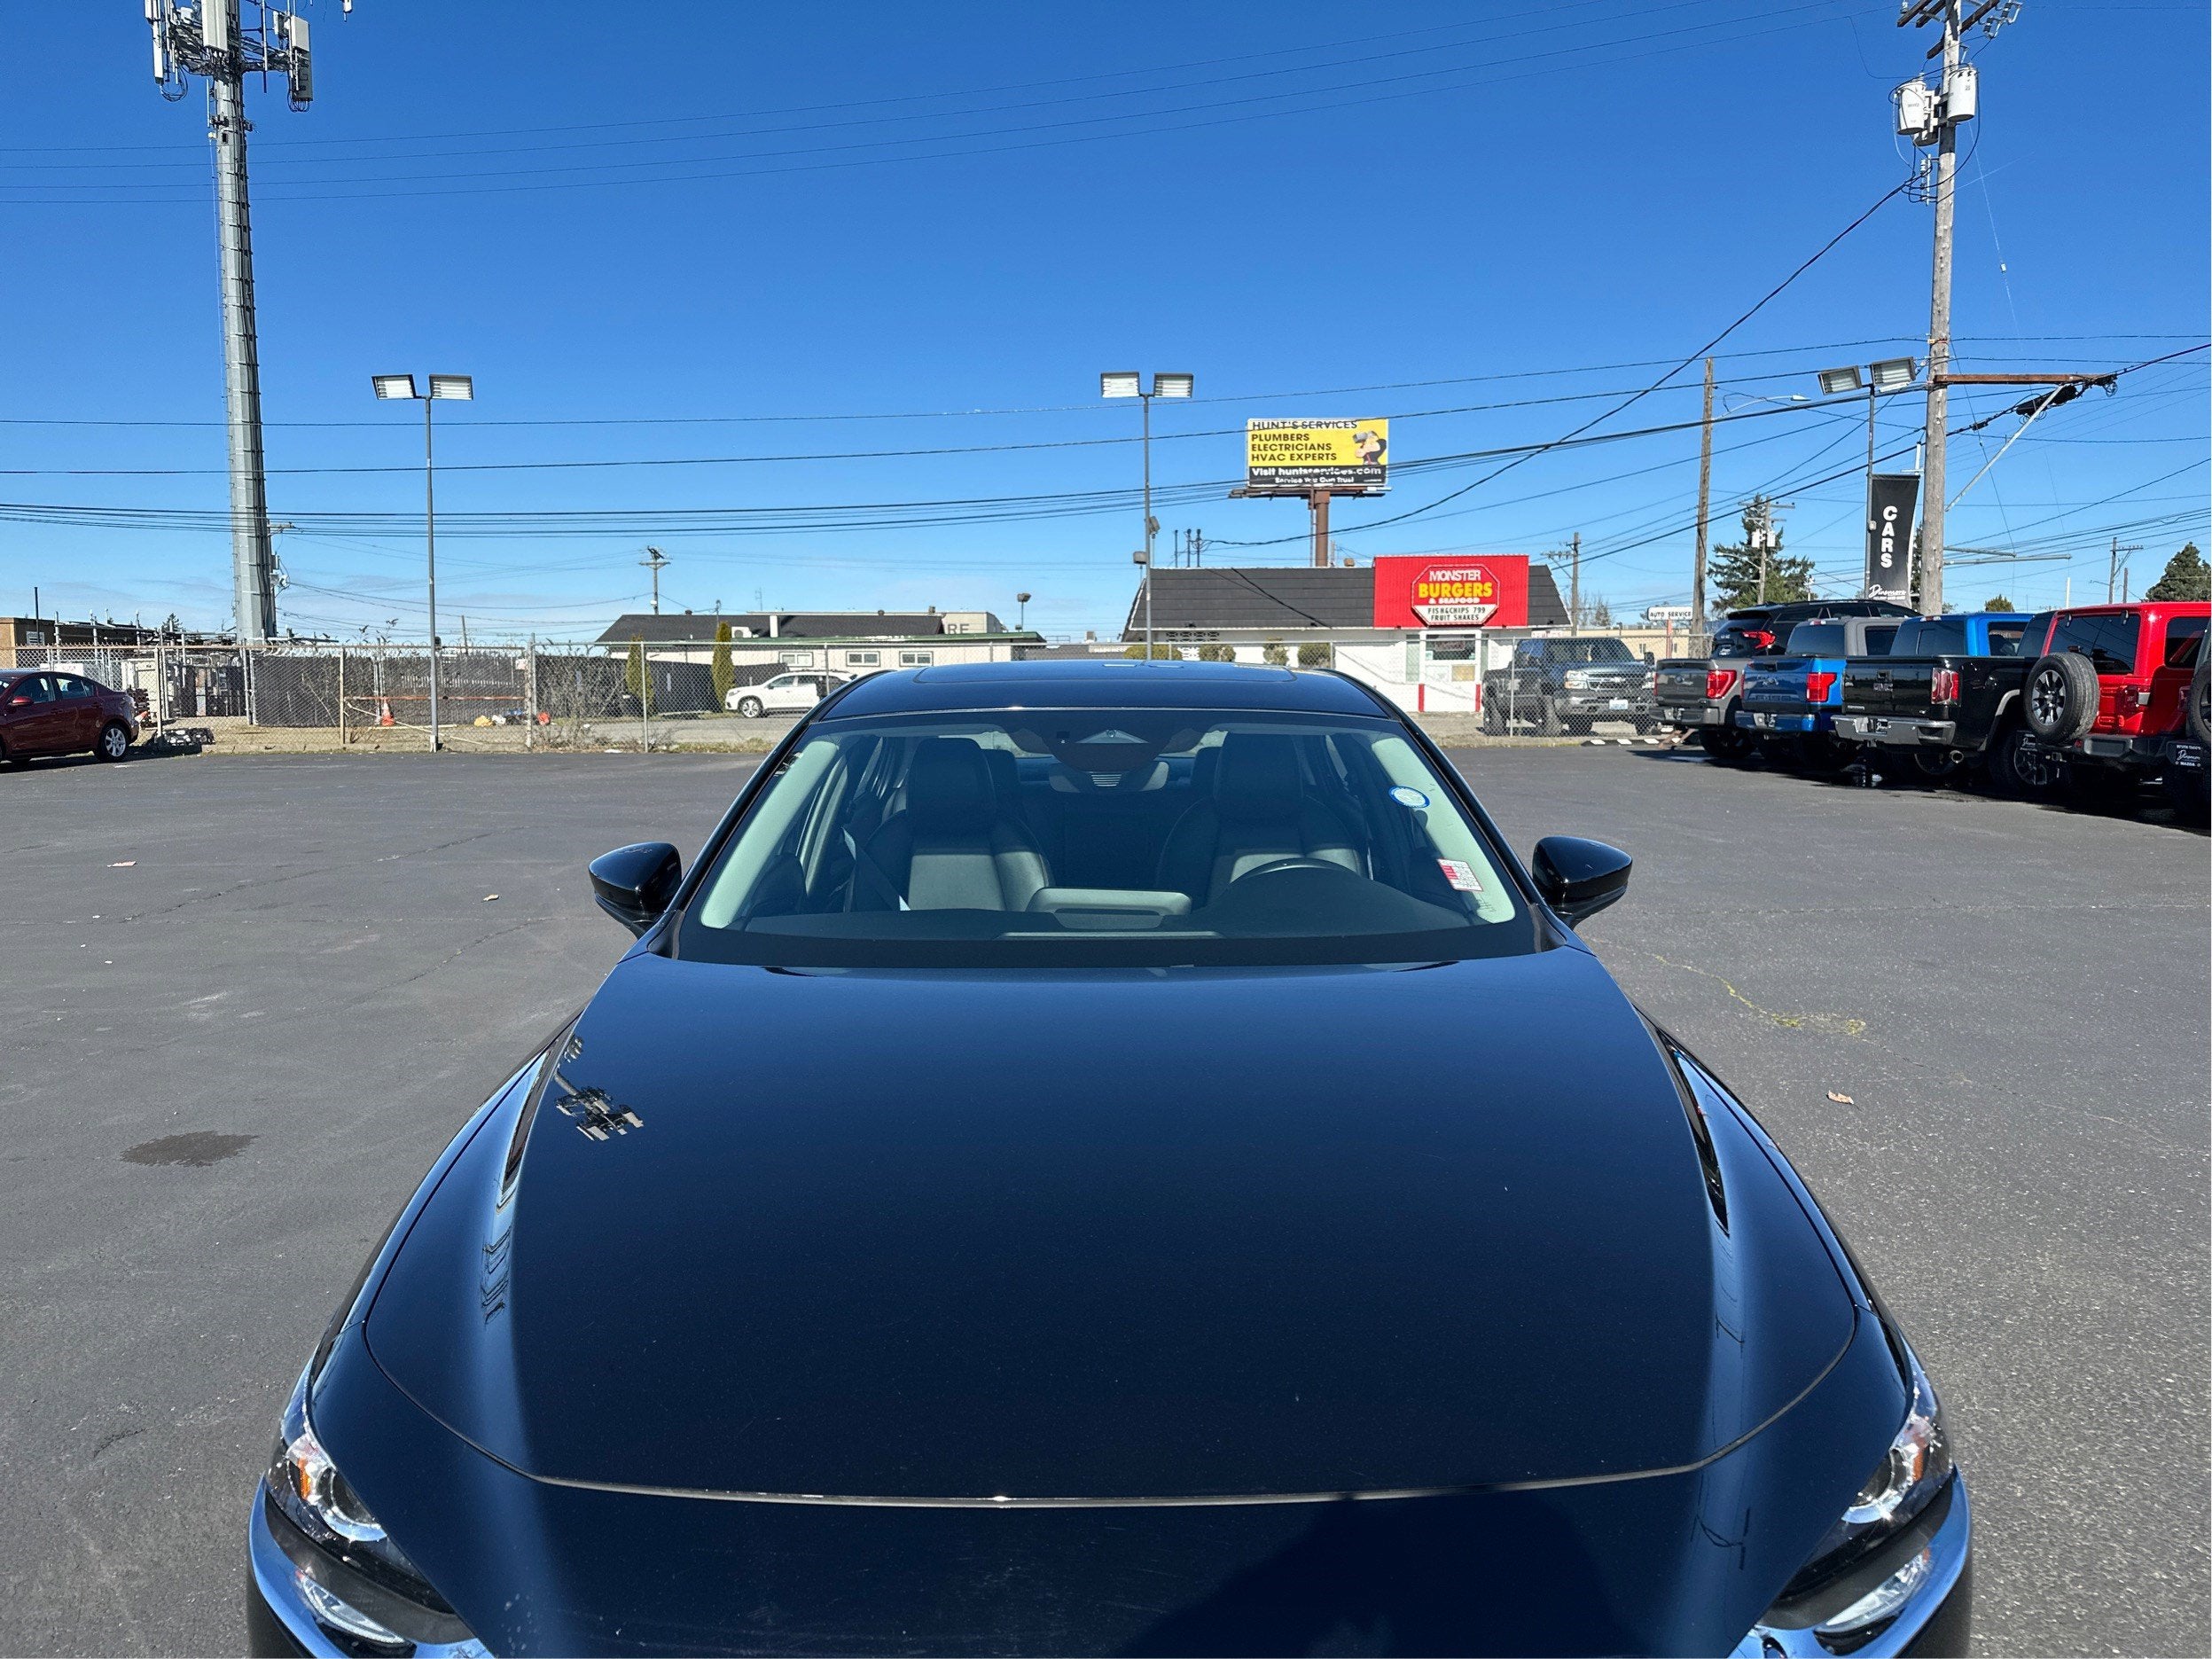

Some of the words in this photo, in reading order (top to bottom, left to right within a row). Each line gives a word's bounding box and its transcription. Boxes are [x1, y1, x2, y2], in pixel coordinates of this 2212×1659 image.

[1252, 421, 1299, 430] HUNT'S
[1301, 420, 1357, 429] SERVICES
[1251, 467, 1276, 476] Visit
[1880, 505, 1898, 568] CARS
[1429, 569, 1481, 582] MONSTER
[1419, 582, 1493, 598] BURGERS
